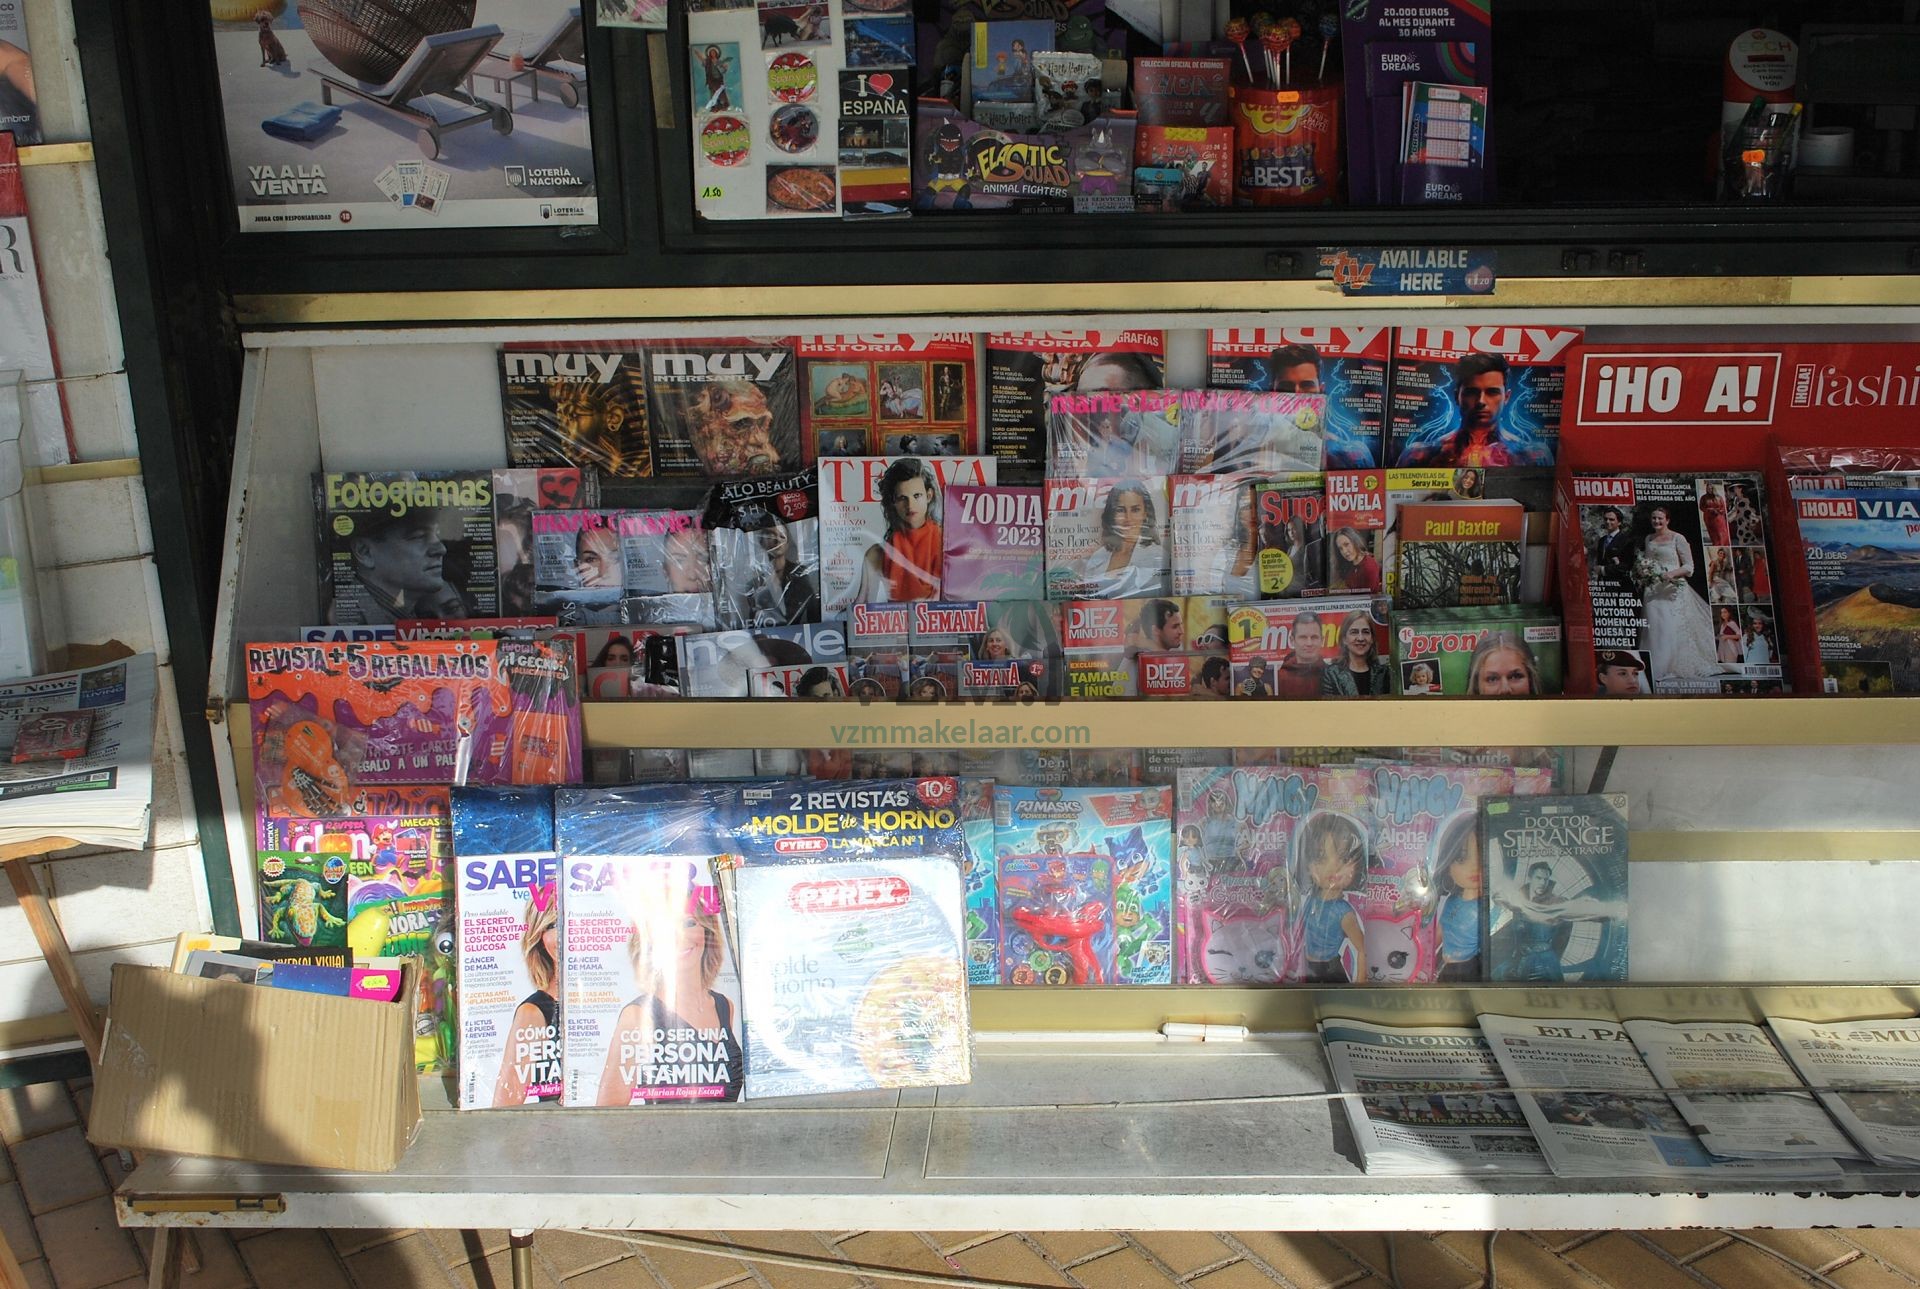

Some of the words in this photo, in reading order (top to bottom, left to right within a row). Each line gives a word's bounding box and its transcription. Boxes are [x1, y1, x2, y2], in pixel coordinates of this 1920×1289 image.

[1384, 8, 1417, 16] 20.000
[1419, 8, 1449, 16] EUROS
[1379, 18, 1391, 26] AL
[1393, 18, 1411, 26] MES
[1413, 18, 1455, 26] DURANTE
[1398, 28, 1410, 36] 30
[1412, 26, 1437, 37] AÑOS
[1381, 54, 1407, 63] EURO
[1381, 62, 1420, 71] DREAMS
[857, 74, 868, 97] I
[843, 99, 907, 115] ESPAÑA
[1009, 110, 1033, 125] Potter
[249, 165, 277, 181] YA
[279, 165, 297, 180] A
[299, 164, 327, 180] LA
[528, 167, 572, 177] LOTERÍA
[1254, 166, 1305, 187] BEST
[249, 179, 329, 196] VENTA
[529, 176, 583, 186] NACIONAL
[1425, 183, 1450, 192] EURO
[702, 187, 722, 198] 1.50
[983, 184, 1020, 194] ANIMAL
[1022, 184, 1068, 199] FIGHTERS
[1425, 191, 1462, 201] DREAMS
[285, 214, 332, 222] RESPONSABILIDAD
[1379, 250, 1468, 269] AVAILABLE
[1400, 273, 1443, 292] HERE
[801, 343, 907, 352] HISTORIA
[990, 336, 1093, 348] HISTORIA
[504, 353, 623, 384] muy
[651, 353, 787, 381] muy
[507, 376, 594, 384] HISTORIA
[653, 374, 754, 383] INTERESANTE
[1794, 367, 1812, 405] ¡HOLA!
[756, 474, 811, 494] BEAUTY
[1328, 475, 1359, 493] TELE
[1411, 480, 1431, 488] Seray
[1432, 480, 1450, 488] Kaya
[1574, 480, 1630, 497] ¡HOLA!
[326, 473, 492, 518] Fotogramas
[1329, 493, 1382, 512] NOVELA
[1801, 500, 1854, 518] ¡HOLA!
[960, 493, 1044, 526] ZODIA
[1424, 520, 1454, 536] Paul
[1457, 520, 1500, 536] Baxter
[997, 526, 1042, 546] 2023
[1048, 535, 1065, 548] las
[1066, 534, 1100, 548] flores
[1807, 547, 1824, 561] 20
[1824, 551, 1848, 560] IDEAS
[1592, 598, 1617, 607] GRAN
[1618, 598, 1643, 608] BODA
[914, 601, 988, 635] SEMANA
[1068, 606, 1119, 630] DIEZ
[1594, 607, 1635, 617] VICTORIA
[1068, 627, 1120, 639] MINUTOS
[1625, 628, 1637, 637] DE
[1818, 641, 1862, 650] SENDERISTAS
[249, 646, 329, 674] REVISTA
[346, 643, 369, 680] 5
[370, 651, 491, 680] REGALAZOS
[1069, 660, 1109, 669] EXCLUSIVA
[963, 661, 1021, 688] SEMANA
[1070, 671, 1131, 684] TAMARA
[1146, 663, 1186, 682] DIEZ
[25, 680, 78, 694] News
[1146, 679, 1187, 689] MINUTOS
[1070, 685, 1081, 697] E
[412, 756, 429, 770] UN
[922, 780, 953, 798] 10€
[789, 794, 803, 811] 2
[807, 789, 911, 810] REVISTAS
[1034, 800, 1084, 813] MASKS
[751, 812, 840, 836] MOLDE
[839, 813, 858, 830] de
[863, 809, 957, 831] HORNO
[1019, 812, 1049, 820] POWER
[1524, 815, 1592, 829] DOCTOR
[831, 838, 850, 848] LA
[850, 836, 899, 848] MARCA
[1379, 828, 1428, 846] Alpha
[1502, 826, 1616, 849] STRANGE
[779, 839, 822, 851] PYREX
[1403, 840, 1427, 850] tour
[512, 889, 531, 900] tve
[799, 883, 896, 909] PYREX
[476, 917, 515, 925] SECRETO
[580, 918, 622, 927] SECRETO
[500, 924, 530, 933] EVITAR
[603, 926, 638, 935] EVITAR
[464, 935, 481, 944] LOS
[482, 934, 508, 943] PICOS
[508, 932, 520, 941] DE
[586, 935, 613, 943] PICOS
[614, 934, 628, 942] DE
[464, 943, 506, 952] GLUCOSA
[567, 943, 613, 952] GLUCOSA
[476, 963, 499, 971] MAMA
[579, 963, 604, 971] MAMA
[515, 1024, 557, 1042] CÓMO
[667, 1028, 696, 1043] SER
[700, 1027, 730, 1042] UNA
[1534, 1025, 1587, 1040] EL
[1682, 1032, 1723, 1043] LA
[620, 1043, 730, 1064] PERSONA
[618, 1063, 731, 1086] VITAMINA
[646, 1088, 675, 1097] Marian
[675, 1088, 698, 1098] Rojas
[698, 1086, 725, 1097] Estapé
